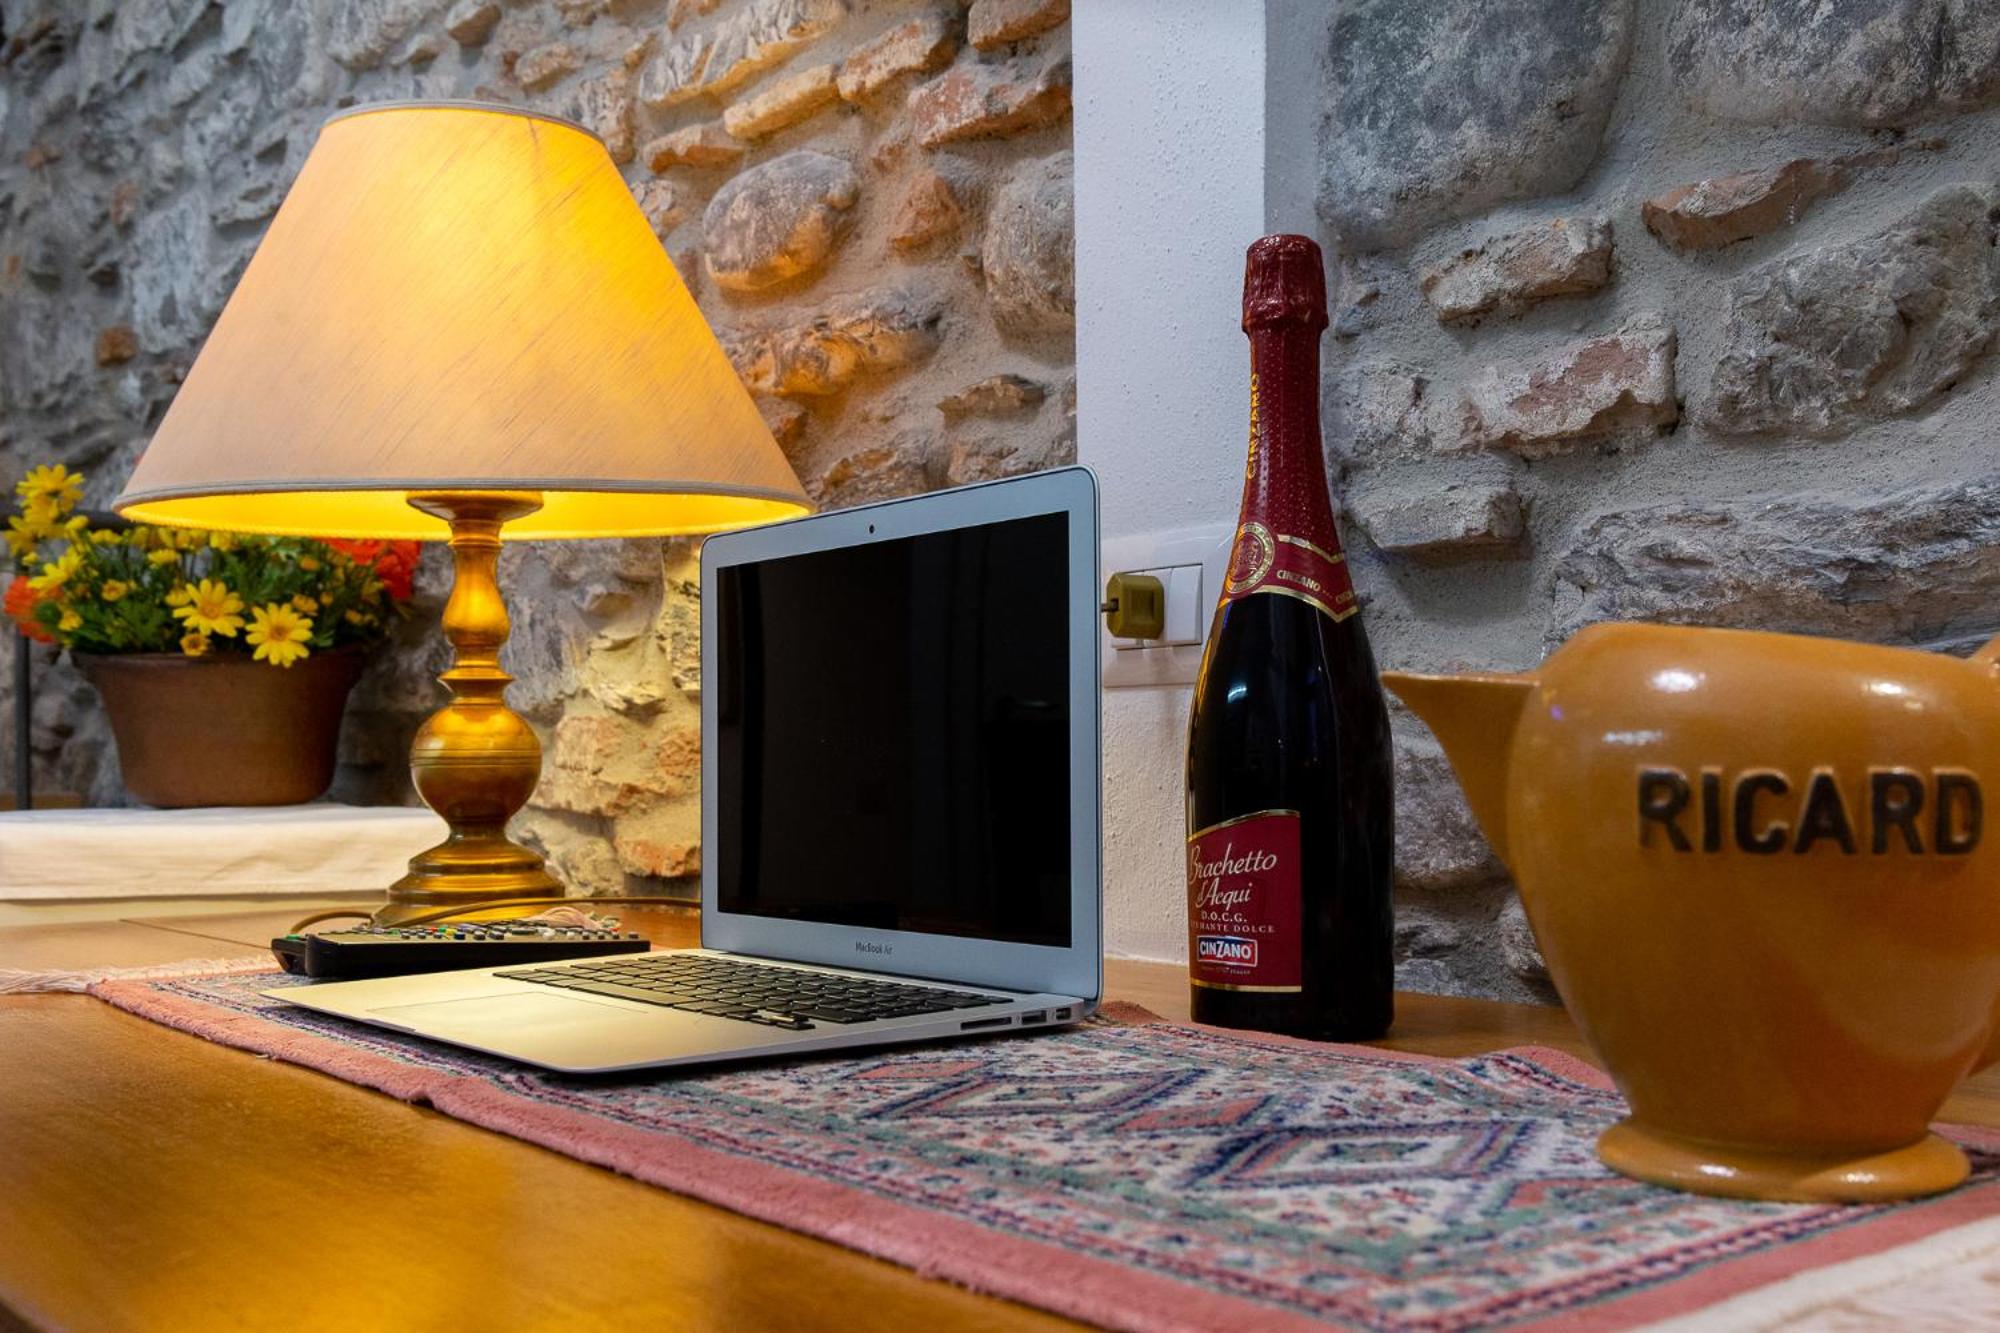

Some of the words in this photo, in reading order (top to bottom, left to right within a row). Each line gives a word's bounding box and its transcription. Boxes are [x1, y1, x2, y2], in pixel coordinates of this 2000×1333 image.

[1277, 569, 1321, 592] CINZANO
[1637, 765, 1984, 855] RICARD
[1189, 842, 1277, 884] Brachetto
[1234, 924, 1275, 933] DOLCE
[1200, 940, 1252, 960] CINZANO
